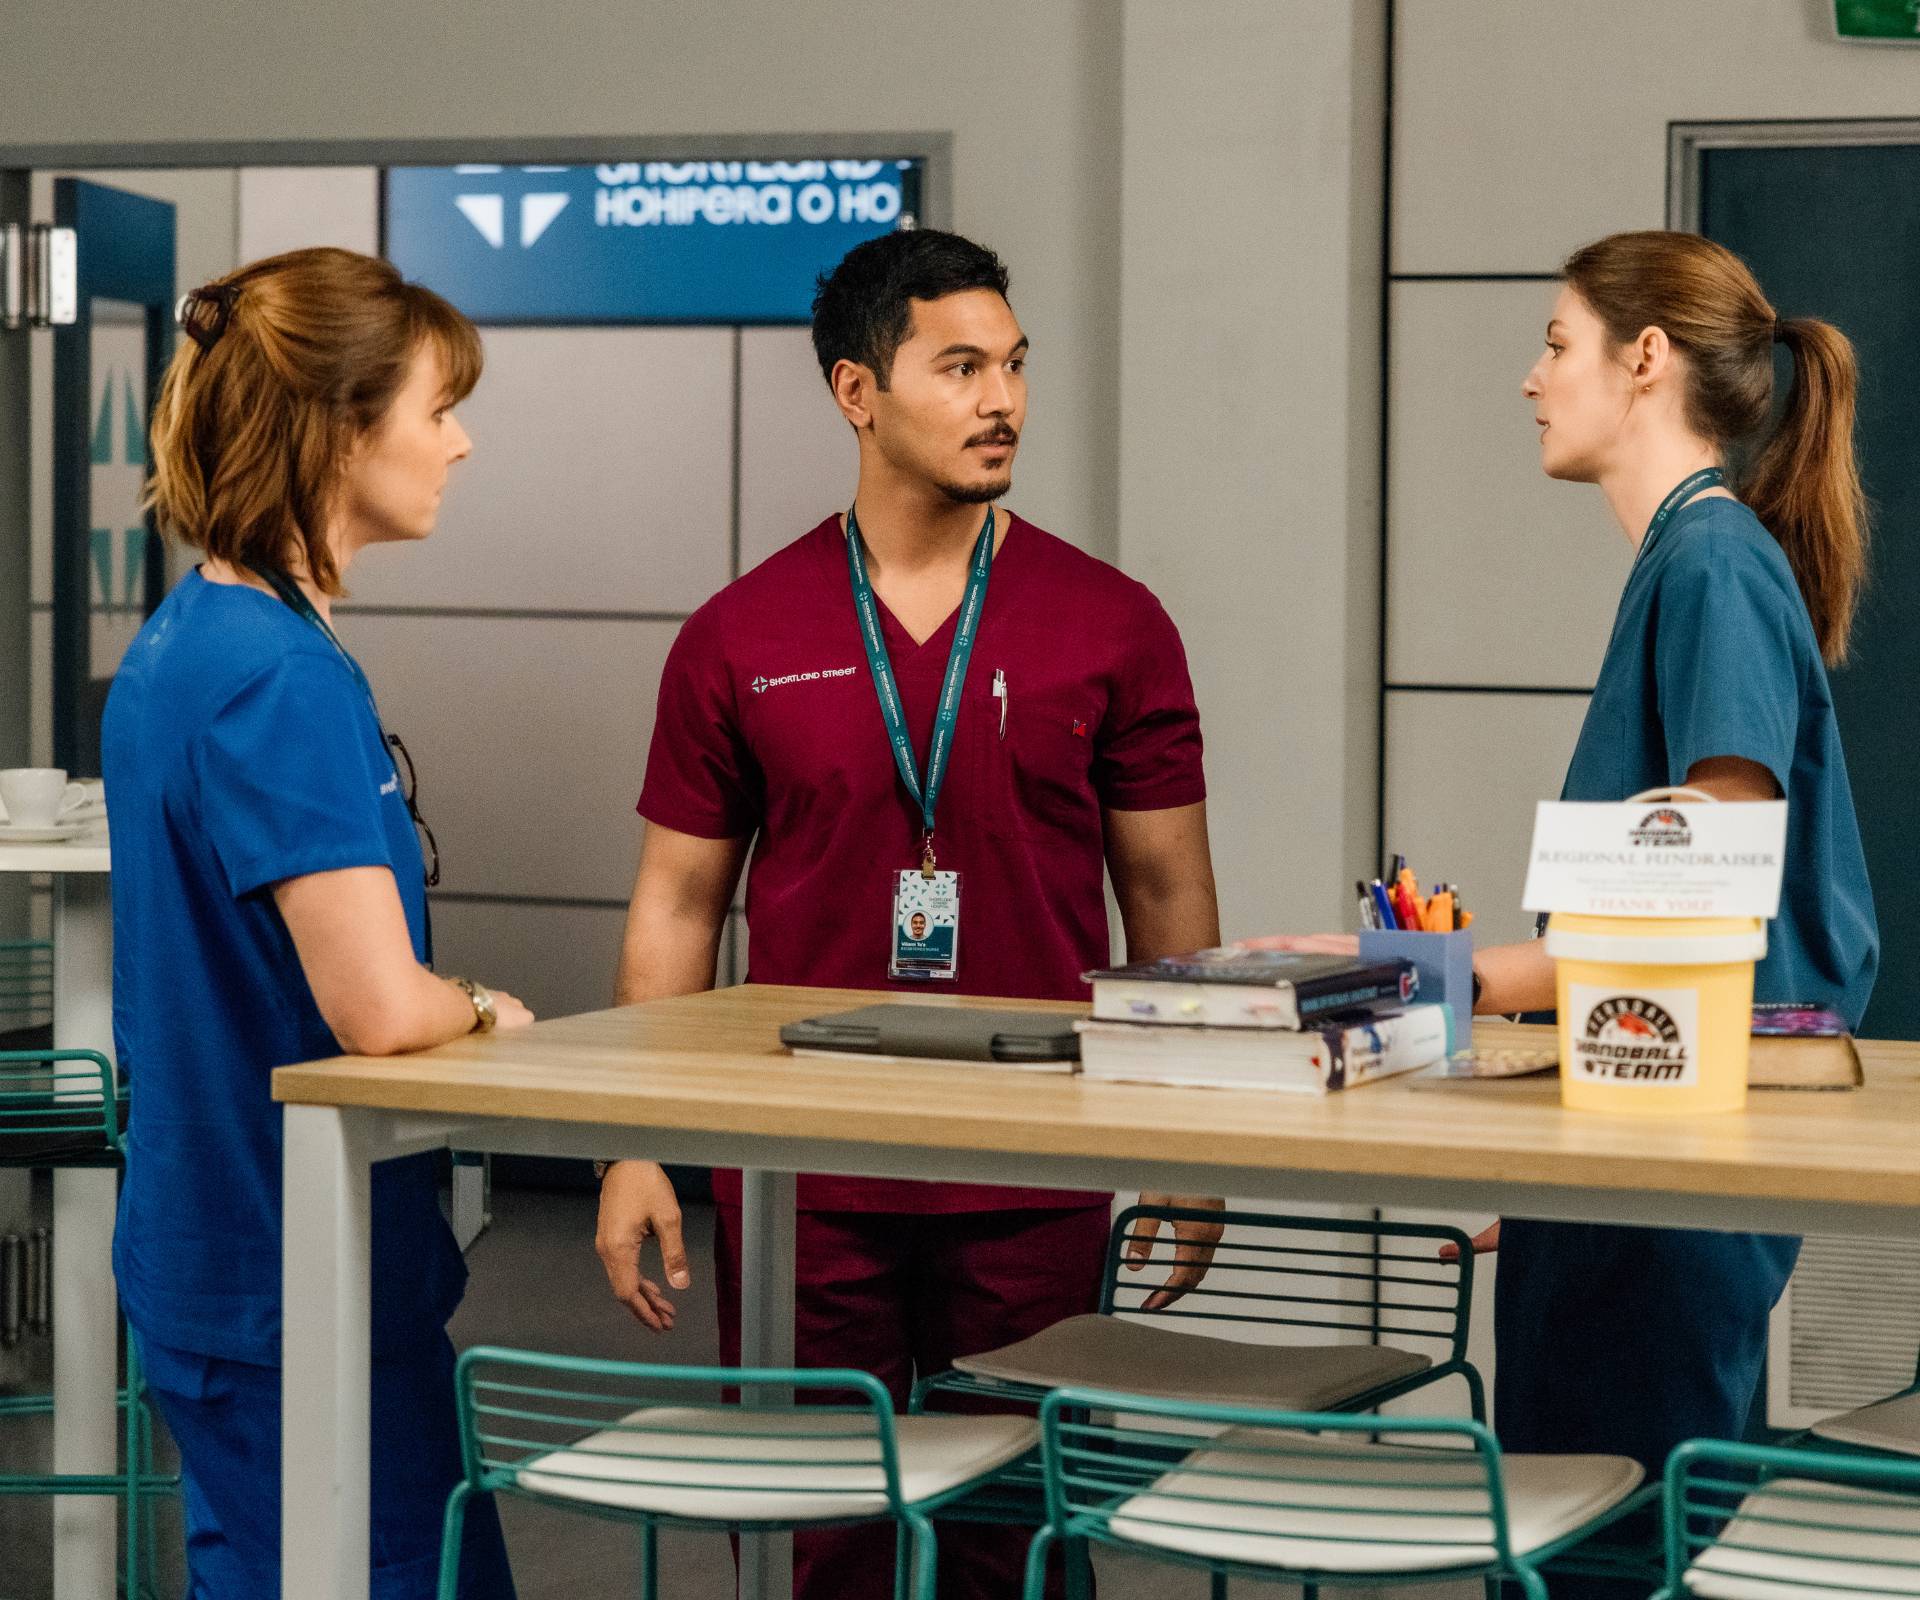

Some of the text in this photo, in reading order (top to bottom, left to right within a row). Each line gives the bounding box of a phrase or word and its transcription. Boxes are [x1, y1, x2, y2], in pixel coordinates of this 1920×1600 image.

[796, 182, 835, 225] O
[1538, 850, 1777, 867] REGIONAL FUNDRAISER
[1576, 1041, 1687, 1060] HANDBALL
[1597, 1061, 1683, 1080] TEAM
